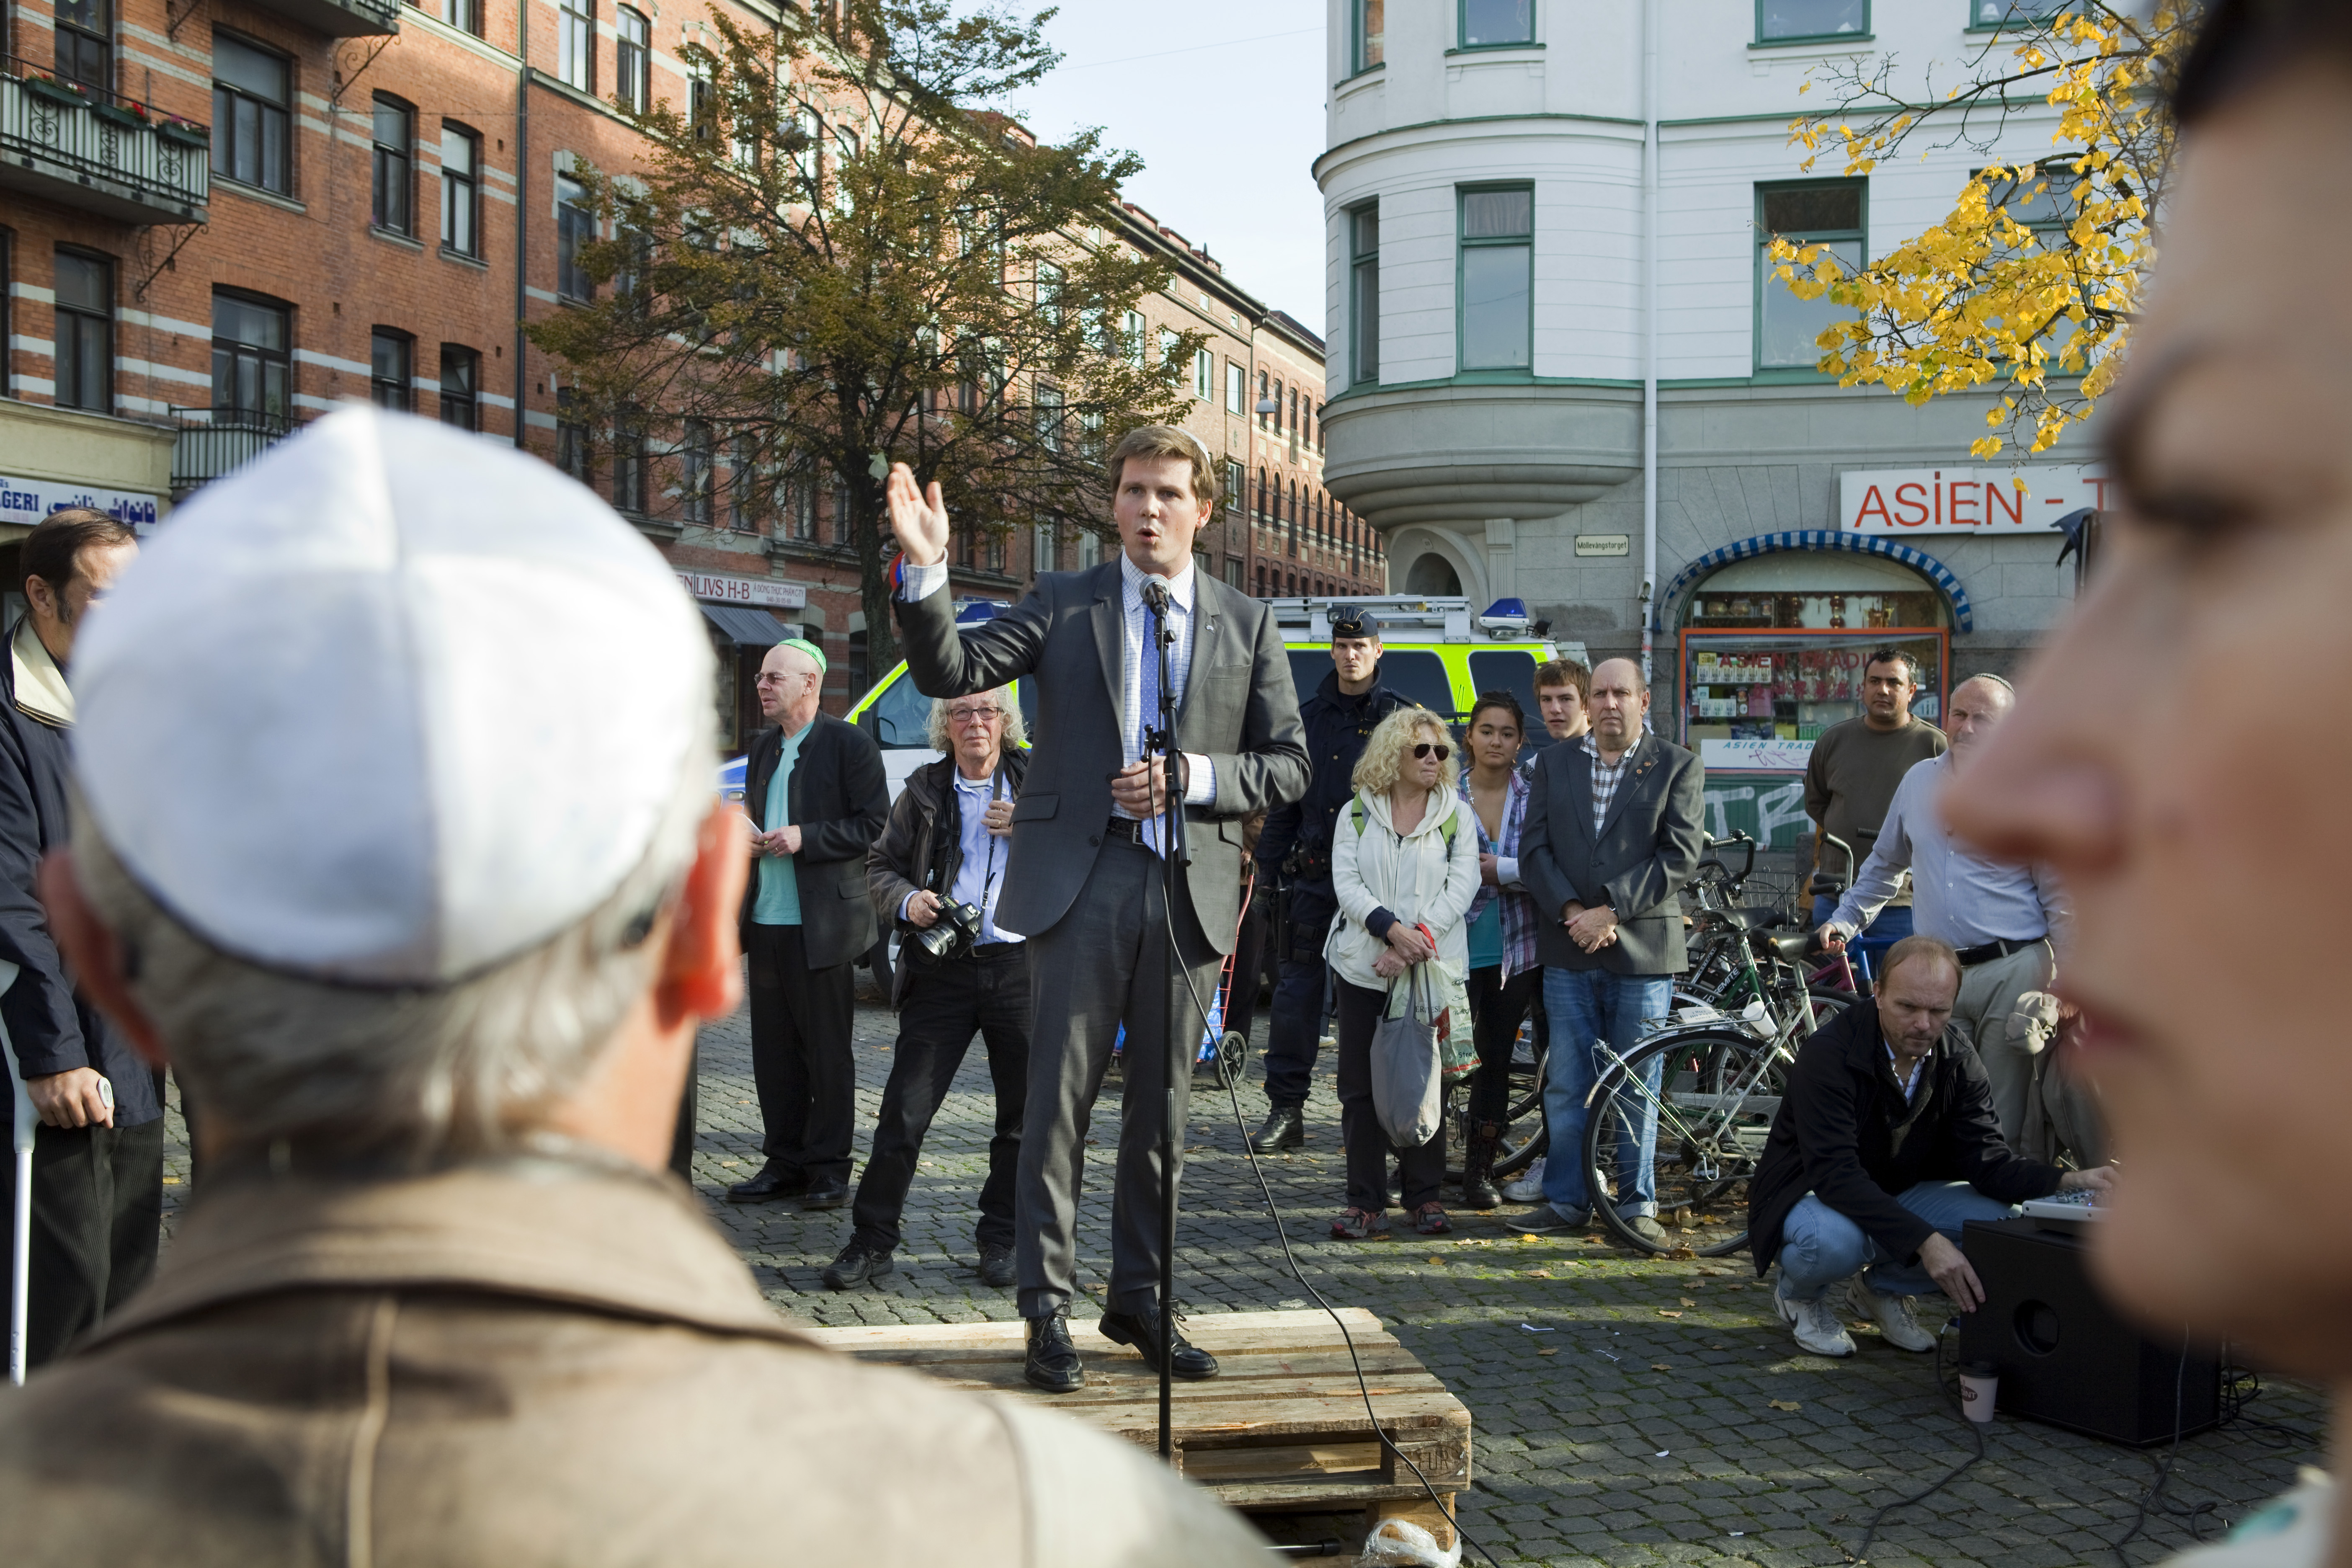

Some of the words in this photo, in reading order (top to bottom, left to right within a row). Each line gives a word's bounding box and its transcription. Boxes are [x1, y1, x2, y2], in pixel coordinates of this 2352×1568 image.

[0, 490, 39, 512] GERI
[1577, 541, 1627, 550] Möllevångstorget
[696, 577, 724, 597] LIVS
[728, 580, 750, 599] H-B
[1719, 652, 1786, 669] ASIEN
[1799, 652, 1875, 670] TRADI
[953, 917, 962, 927] Canon
